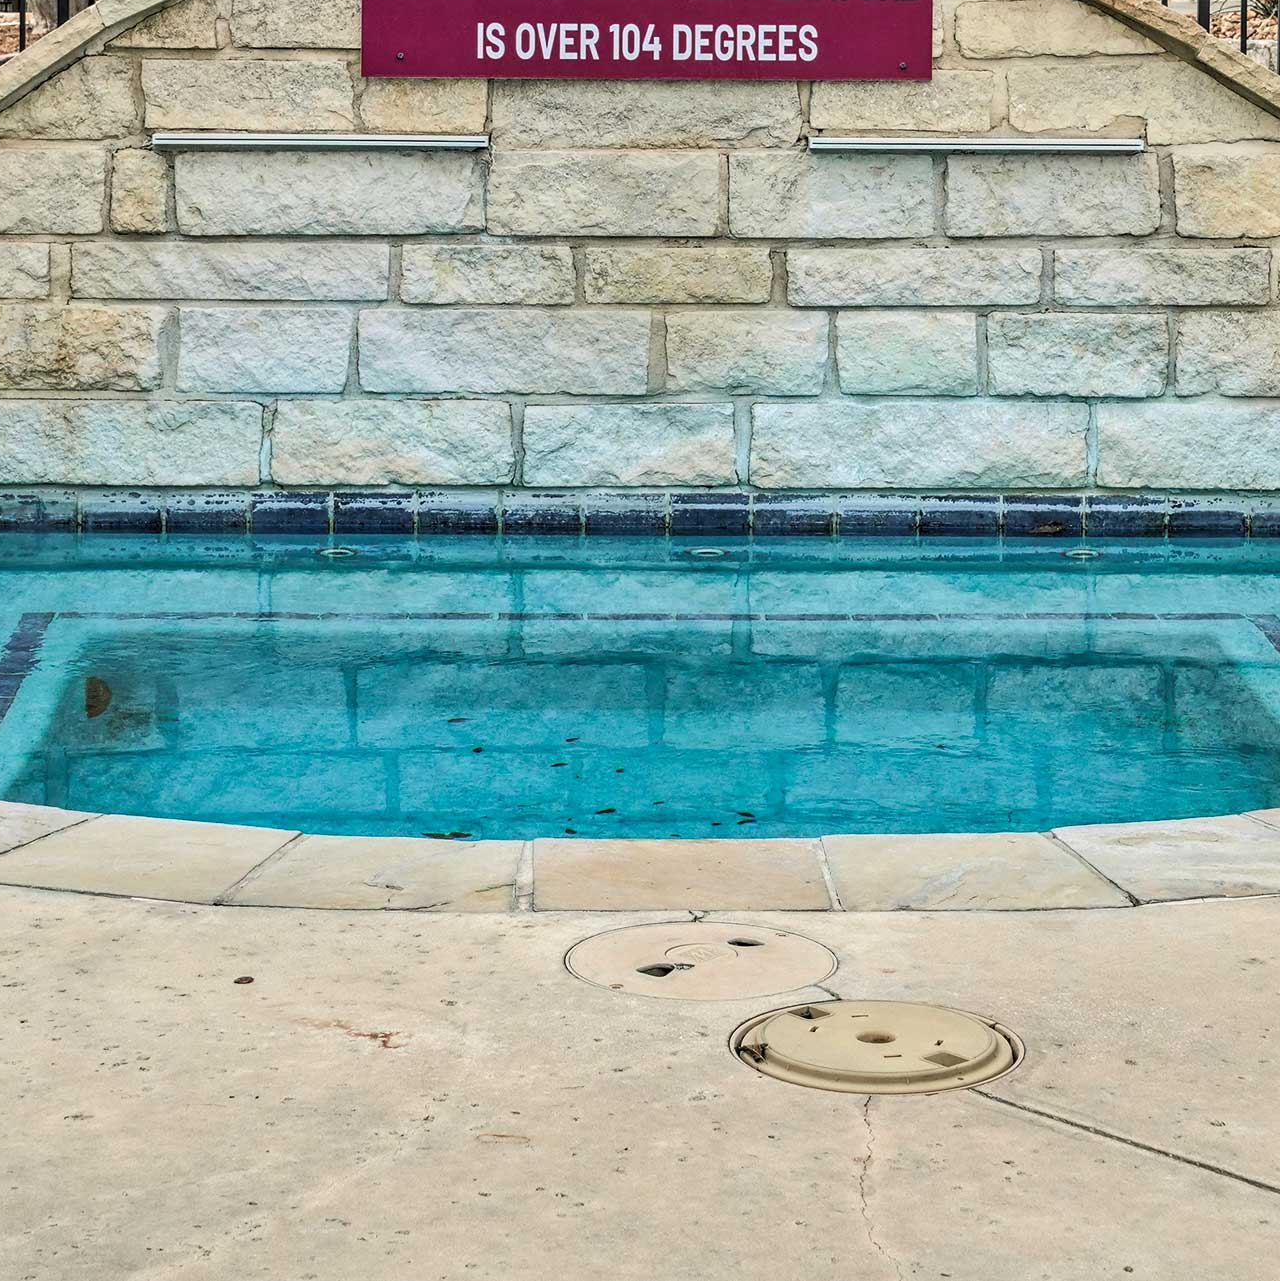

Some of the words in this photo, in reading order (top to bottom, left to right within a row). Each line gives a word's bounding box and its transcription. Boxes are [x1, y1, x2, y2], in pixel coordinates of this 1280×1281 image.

[476, 22, 506, 60] IS
[515, 22, 600, 61] OVER
[609, 23, 663, 61] 104
[672, 23, 819, 62] DEGREES
